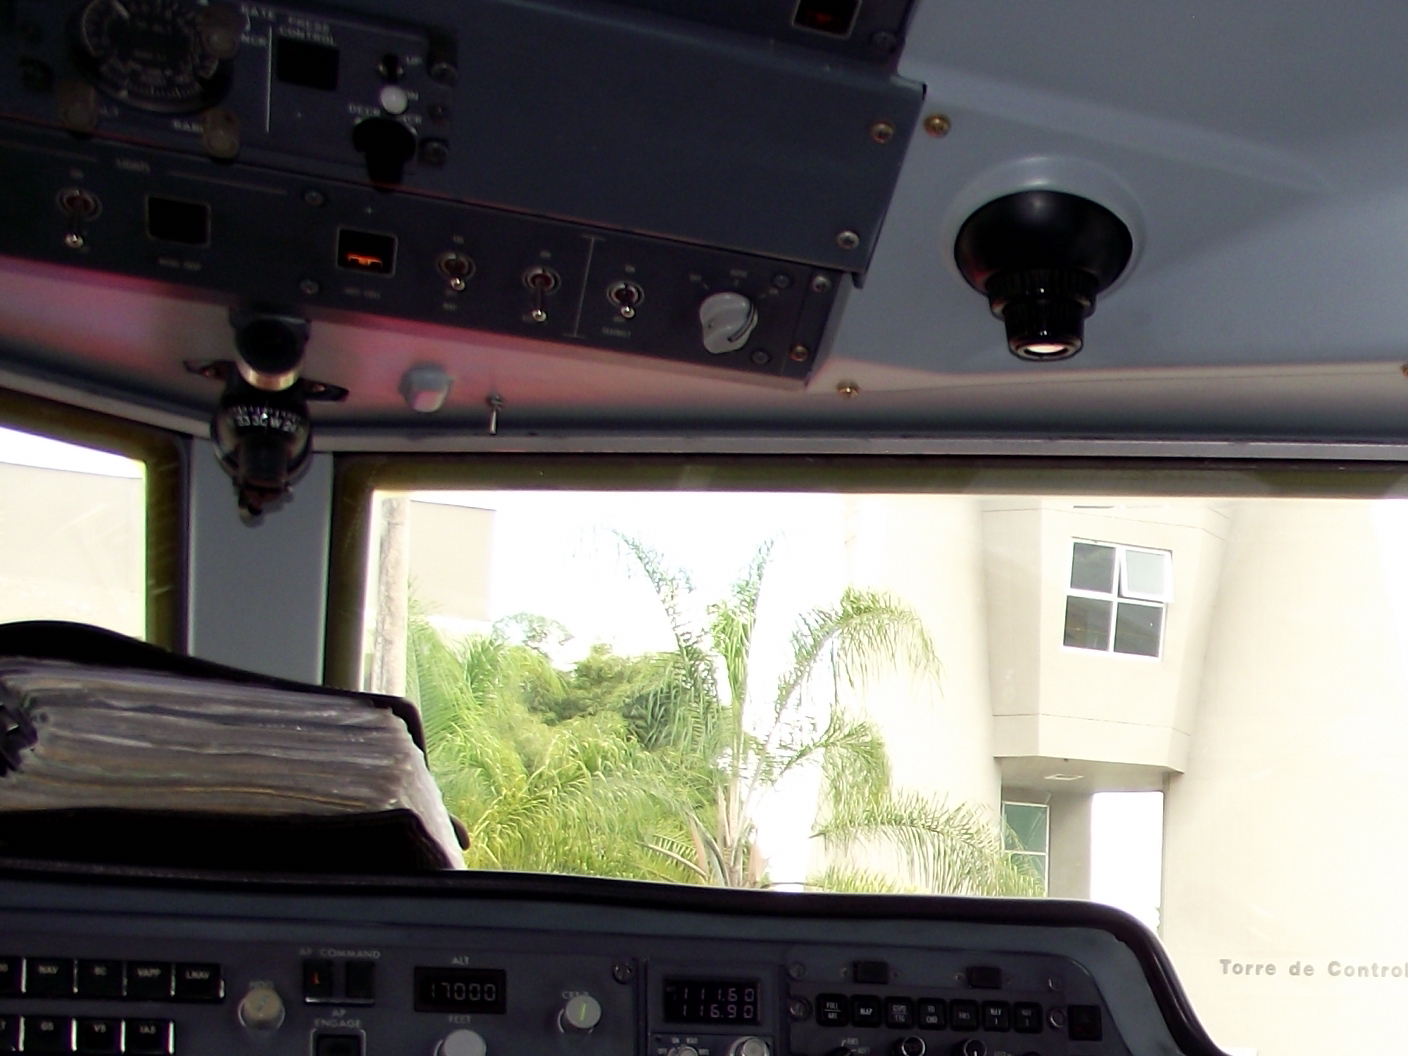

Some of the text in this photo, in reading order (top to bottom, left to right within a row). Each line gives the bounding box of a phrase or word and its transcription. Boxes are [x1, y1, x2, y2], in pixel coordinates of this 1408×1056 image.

[280, 28, 336, 47] CONTROL
[319, 948, 381, 960] COMMAND
[452, 955, 470, 966] ALT
[1220, 959, 1276, 976] Torre
[1289, 961, 1315, 977] de
[430, 981, 497, 1002] 17000
[314, 1018, 362, 1030] ENGAGE
